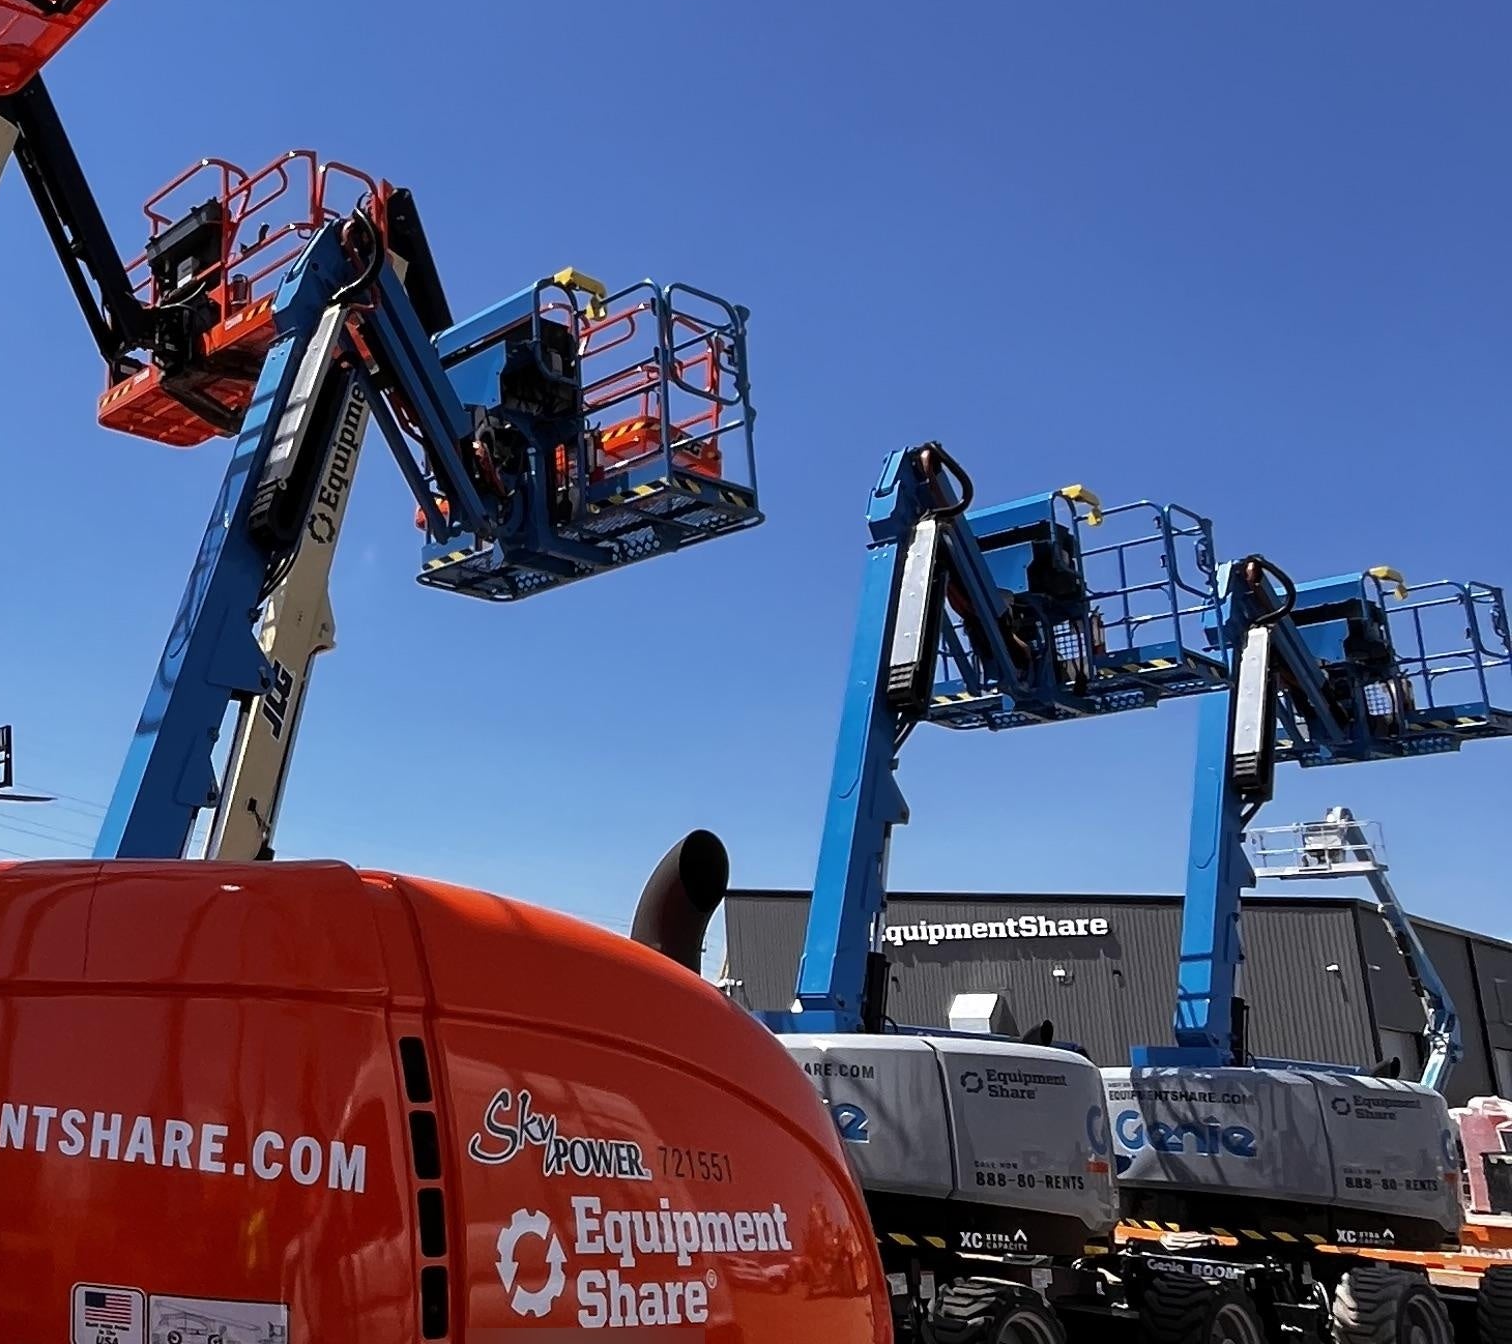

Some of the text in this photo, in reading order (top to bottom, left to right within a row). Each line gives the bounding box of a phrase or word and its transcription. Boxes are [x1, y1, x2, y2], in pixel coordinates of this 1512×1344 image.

[986, 1068, 1066, 1087] Equipment
[988, 1085, 1036, 1099] Share
[1109, 1090, 1255, 1105] EQUIPMENTSHARE.COM
[1354, 1108, 1397, 1120] Share
[1115, 1110, 1257, 1157] Genie
[551, 1137, 652, 1181] POWER
[658, 1146, 733, 1184] 721551
[976, 1171, 1085, 1190] 888-80-RENTS
[571, 1196, 792, 1267] Equipment
[960, 1232, 982, 1248] XC
[1336, 1229, 1357, 1243] XC
[1147, 1258, 1185, 1274] Genie
[577, 1269, 708, 1329] Share
